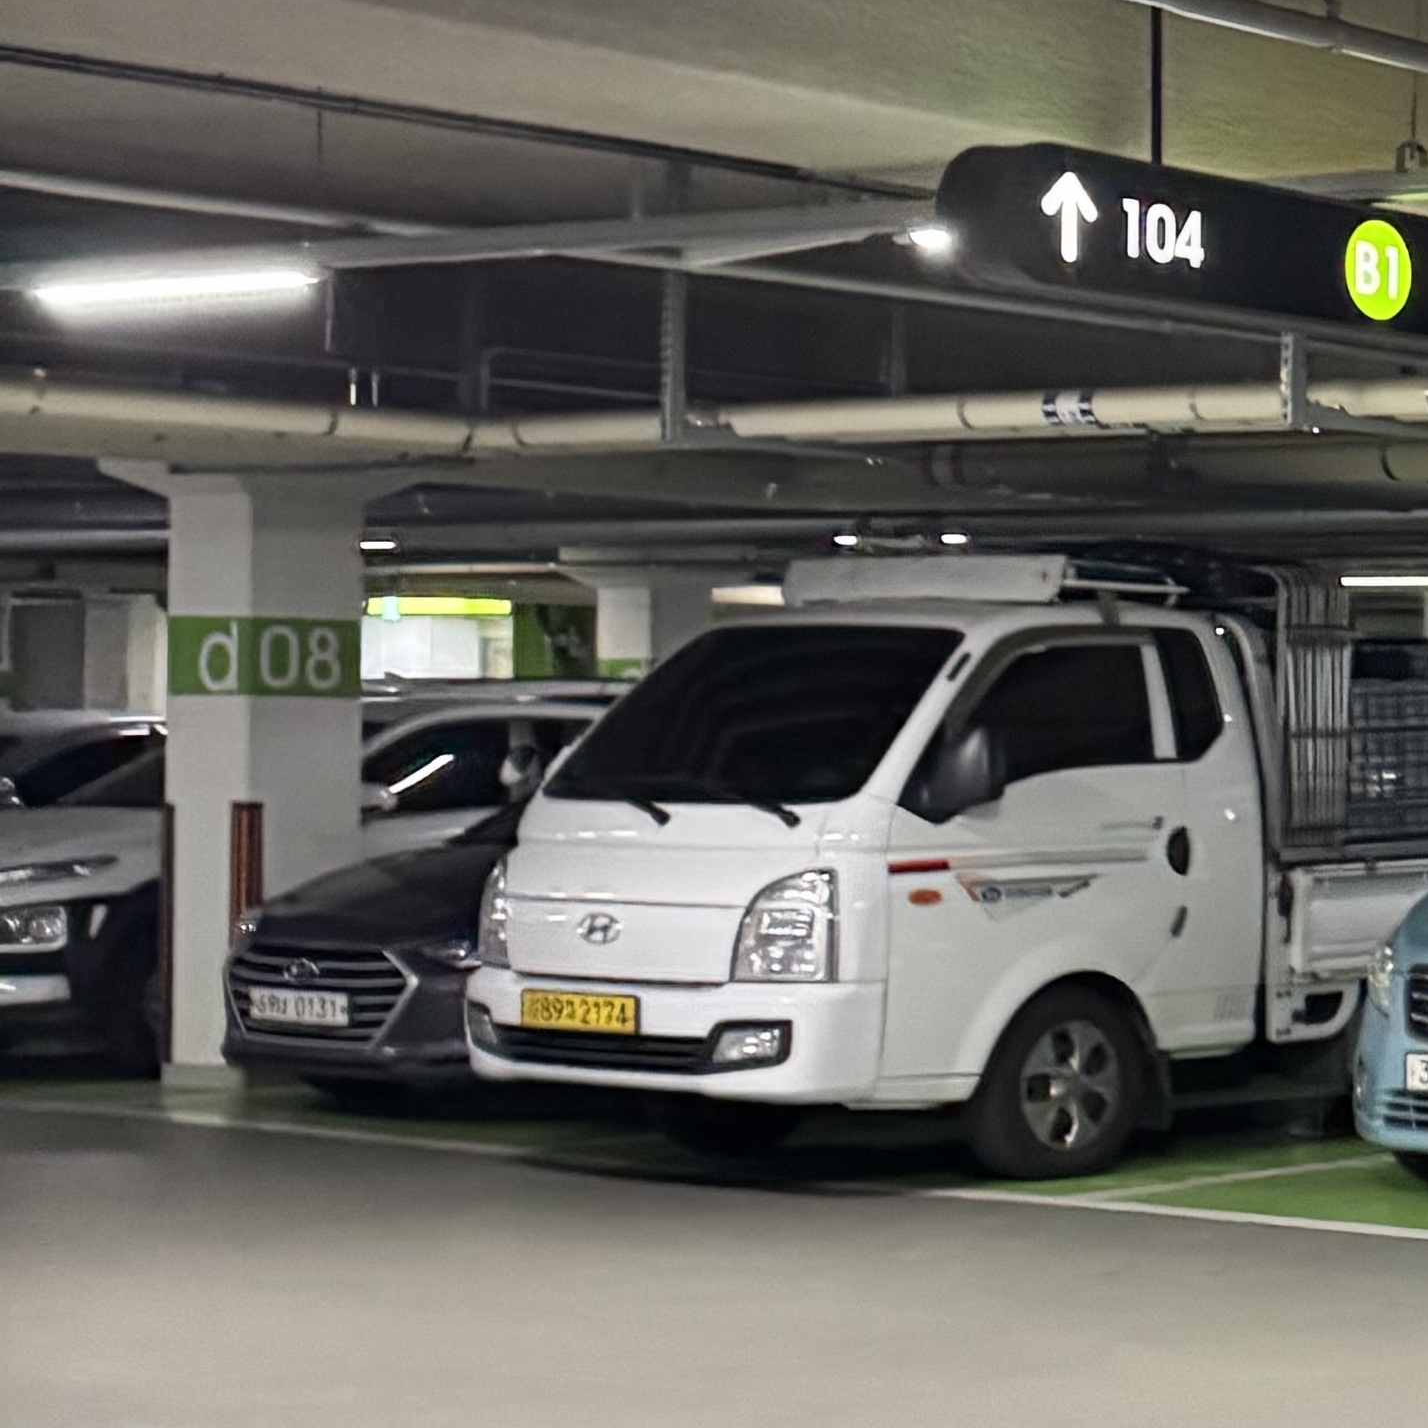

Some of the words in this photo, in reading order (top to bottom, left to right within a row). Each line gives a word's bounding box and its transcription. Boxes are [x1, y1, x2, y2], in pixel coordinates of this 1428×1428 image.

[1122, 197, 1205, 269] 104
[1354, 240, 1399, 300] B1
[198, 620, 239, 691] d
[259, 625, 342, 689] 08
